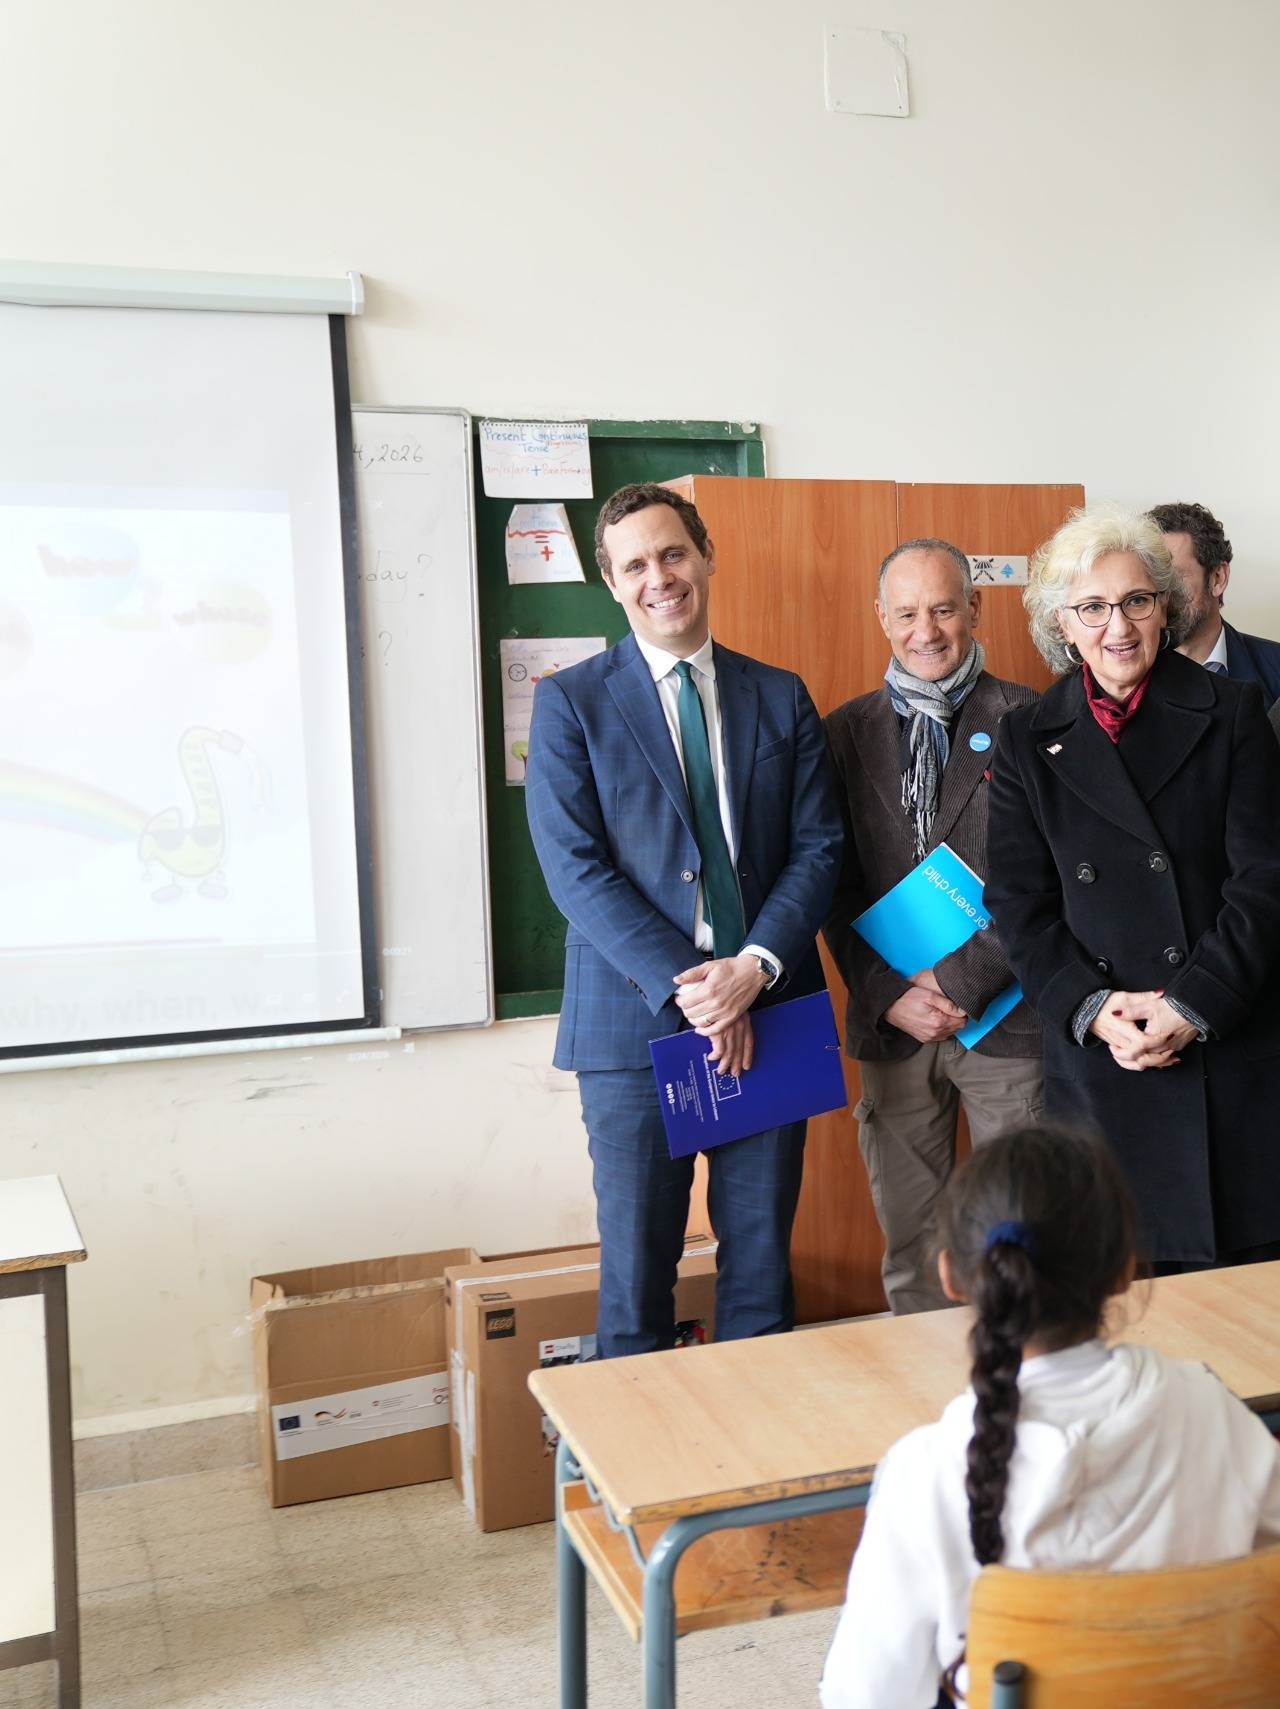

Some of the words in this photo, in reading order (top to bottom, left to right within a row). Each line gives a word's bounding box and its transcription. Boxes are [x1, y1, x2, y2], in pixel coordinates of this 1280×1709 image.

[485, 427, 527, 441] Present
[921, 864, 950, 891] child
[946, 887, 977, 917] every
[486, 1315, 514, 1333] LEGO
